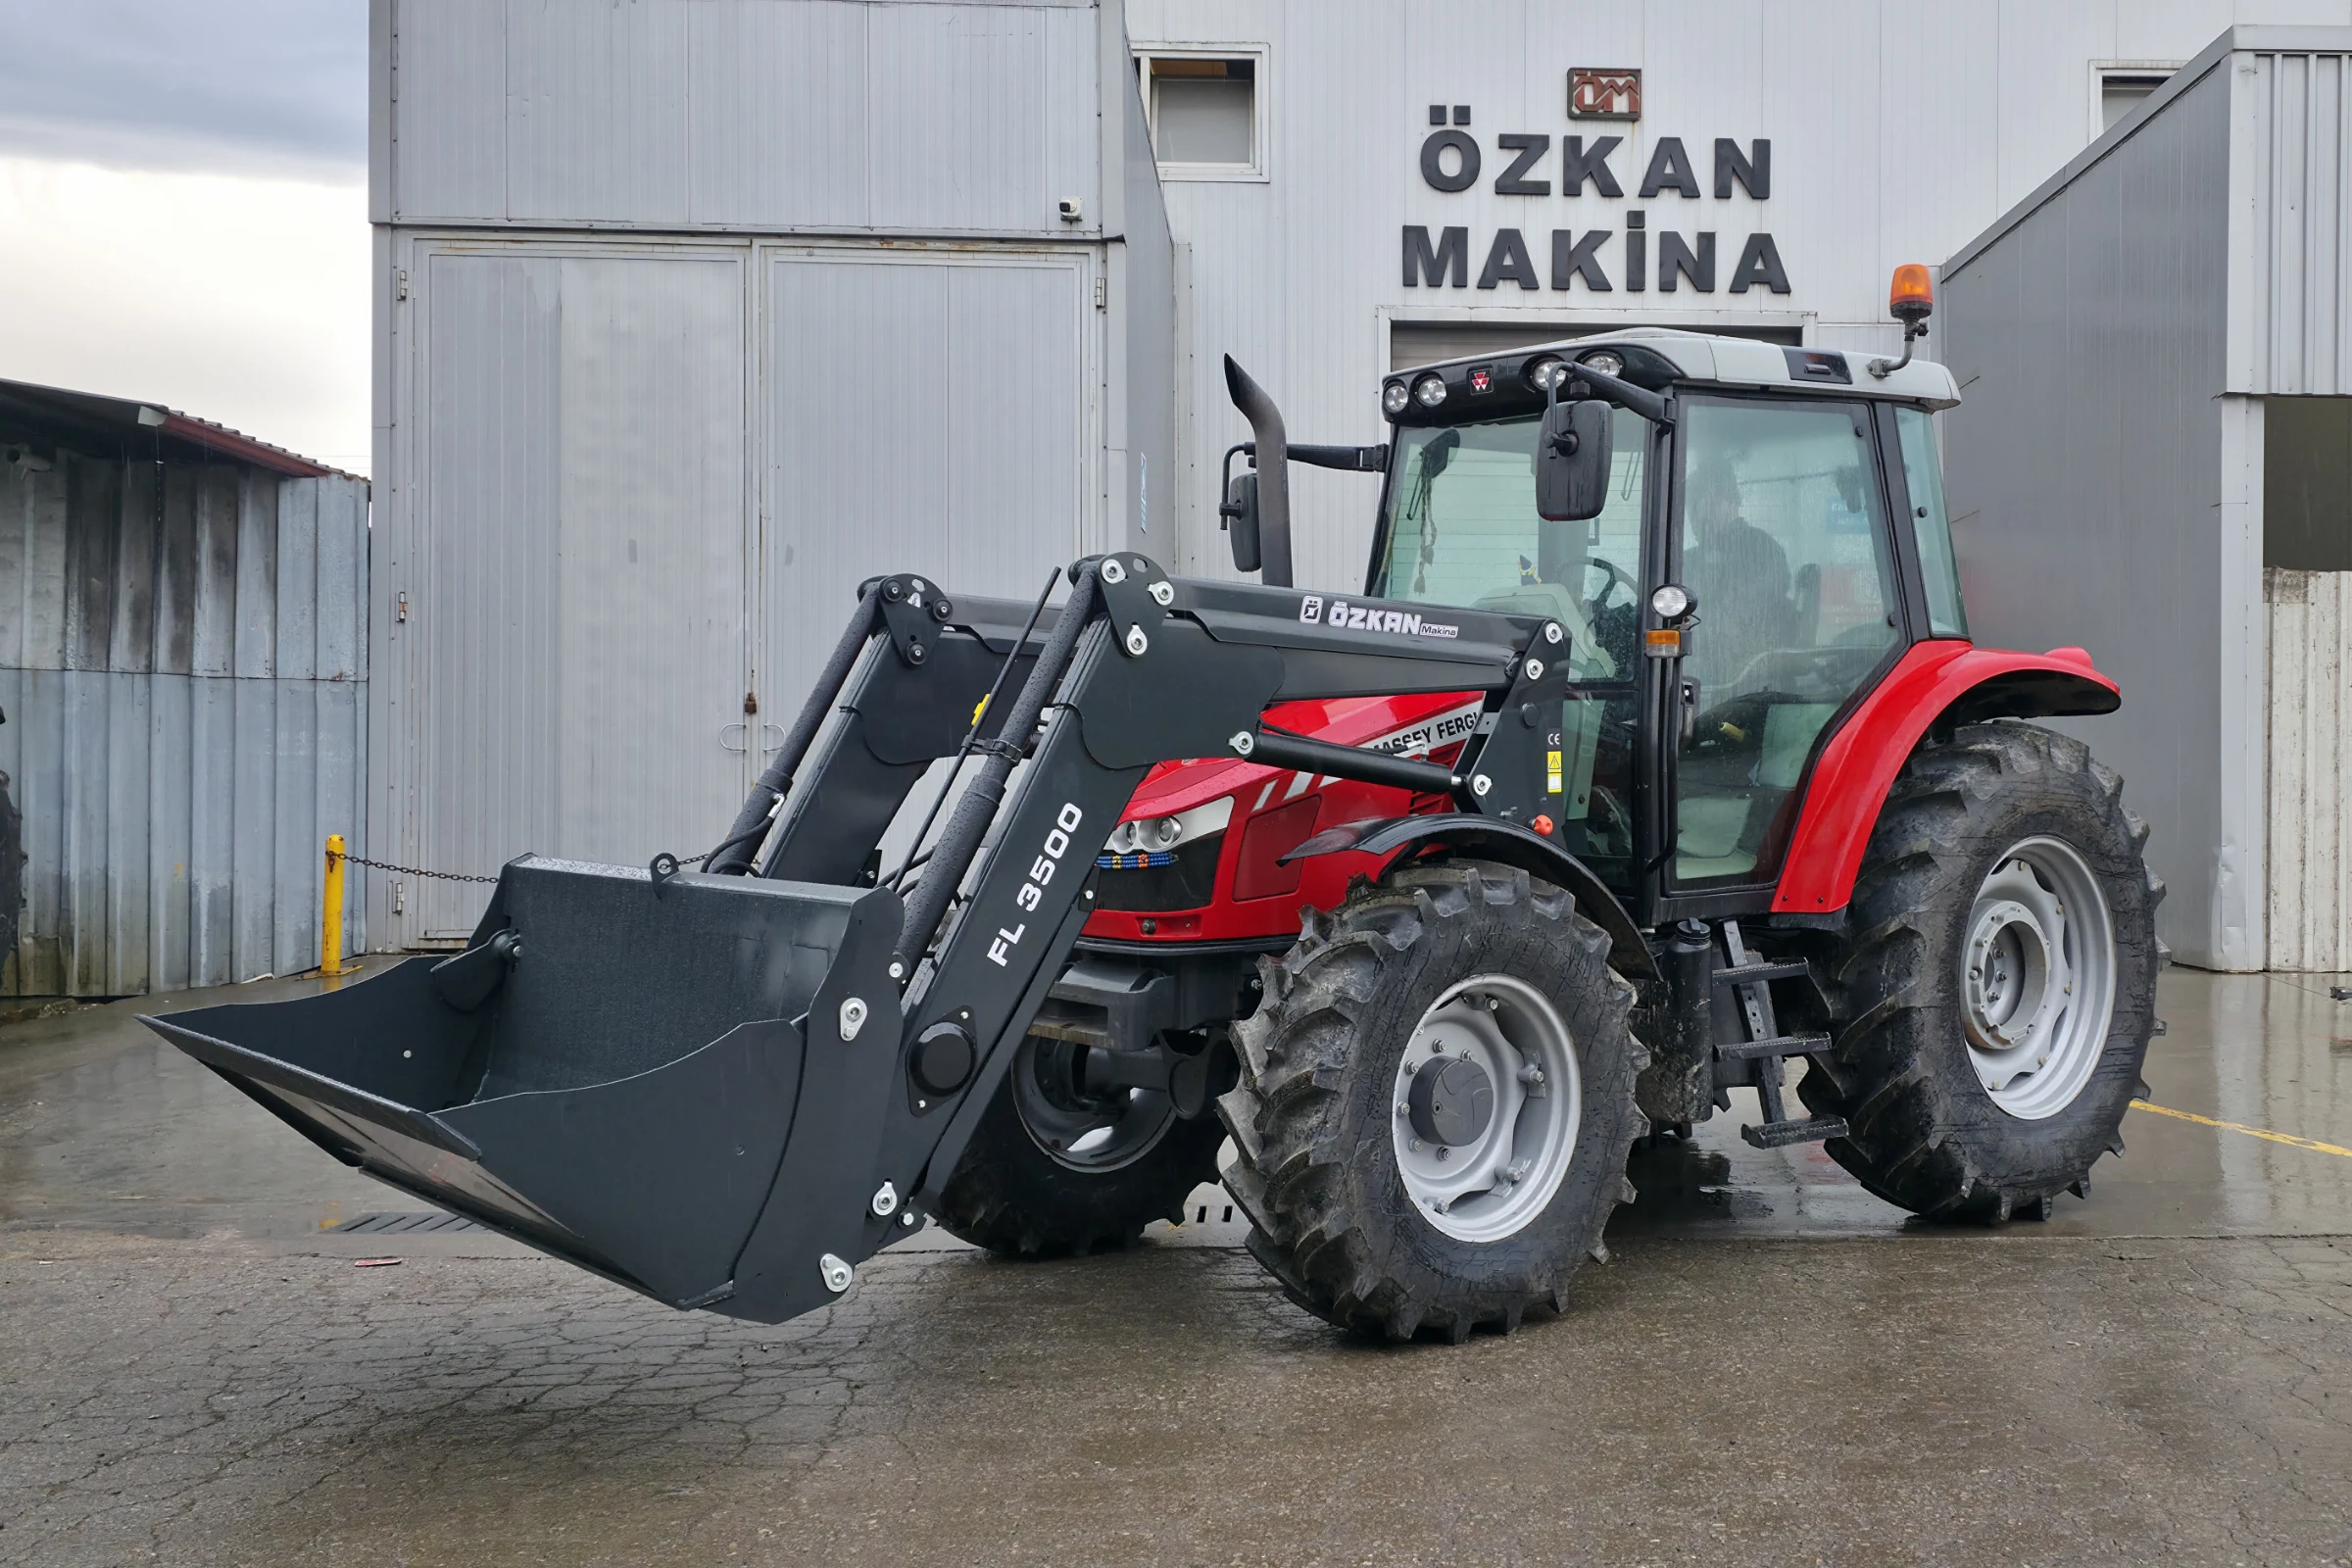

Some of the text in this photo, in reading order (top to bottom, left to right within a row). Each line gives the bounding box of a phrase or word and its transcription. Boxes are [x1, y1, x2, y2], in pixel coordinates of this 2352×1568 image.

[1419, 104, 1772, 200] ÖZKAN
[1401, 210, 1791, 294] MAKİNA
[1328, 601, 1422, 635] ÖZKAN
[1421, 625, 1457, 637] Makina
[1373, 726, 1431, 750] SSEY
[1547, 733, 1560, 746] CE
[987, 802, 1083, 967] FL 3500
